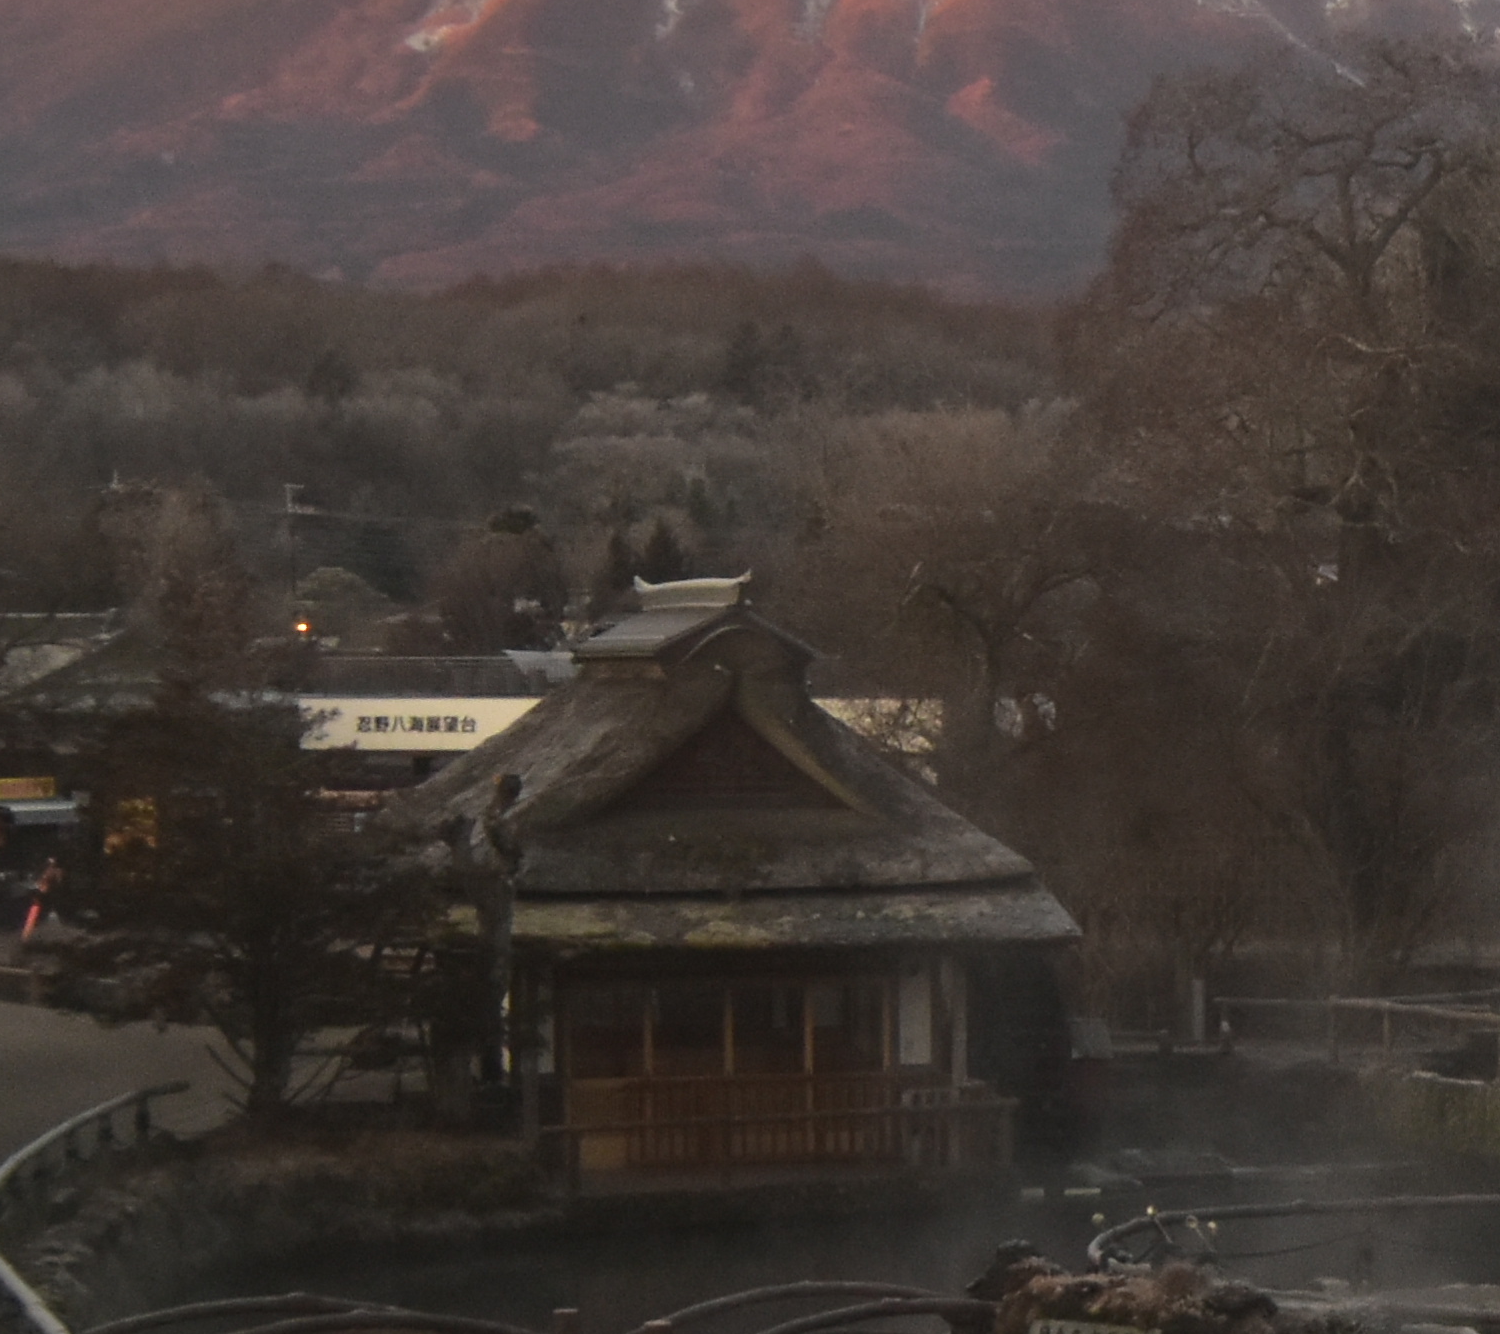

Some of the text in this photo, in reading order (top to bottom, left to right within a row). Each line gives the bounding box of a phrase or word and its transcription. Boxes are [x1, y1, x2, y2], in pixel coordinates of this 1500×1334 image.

[357, 716, 477, 733] 忍野八海展望台
